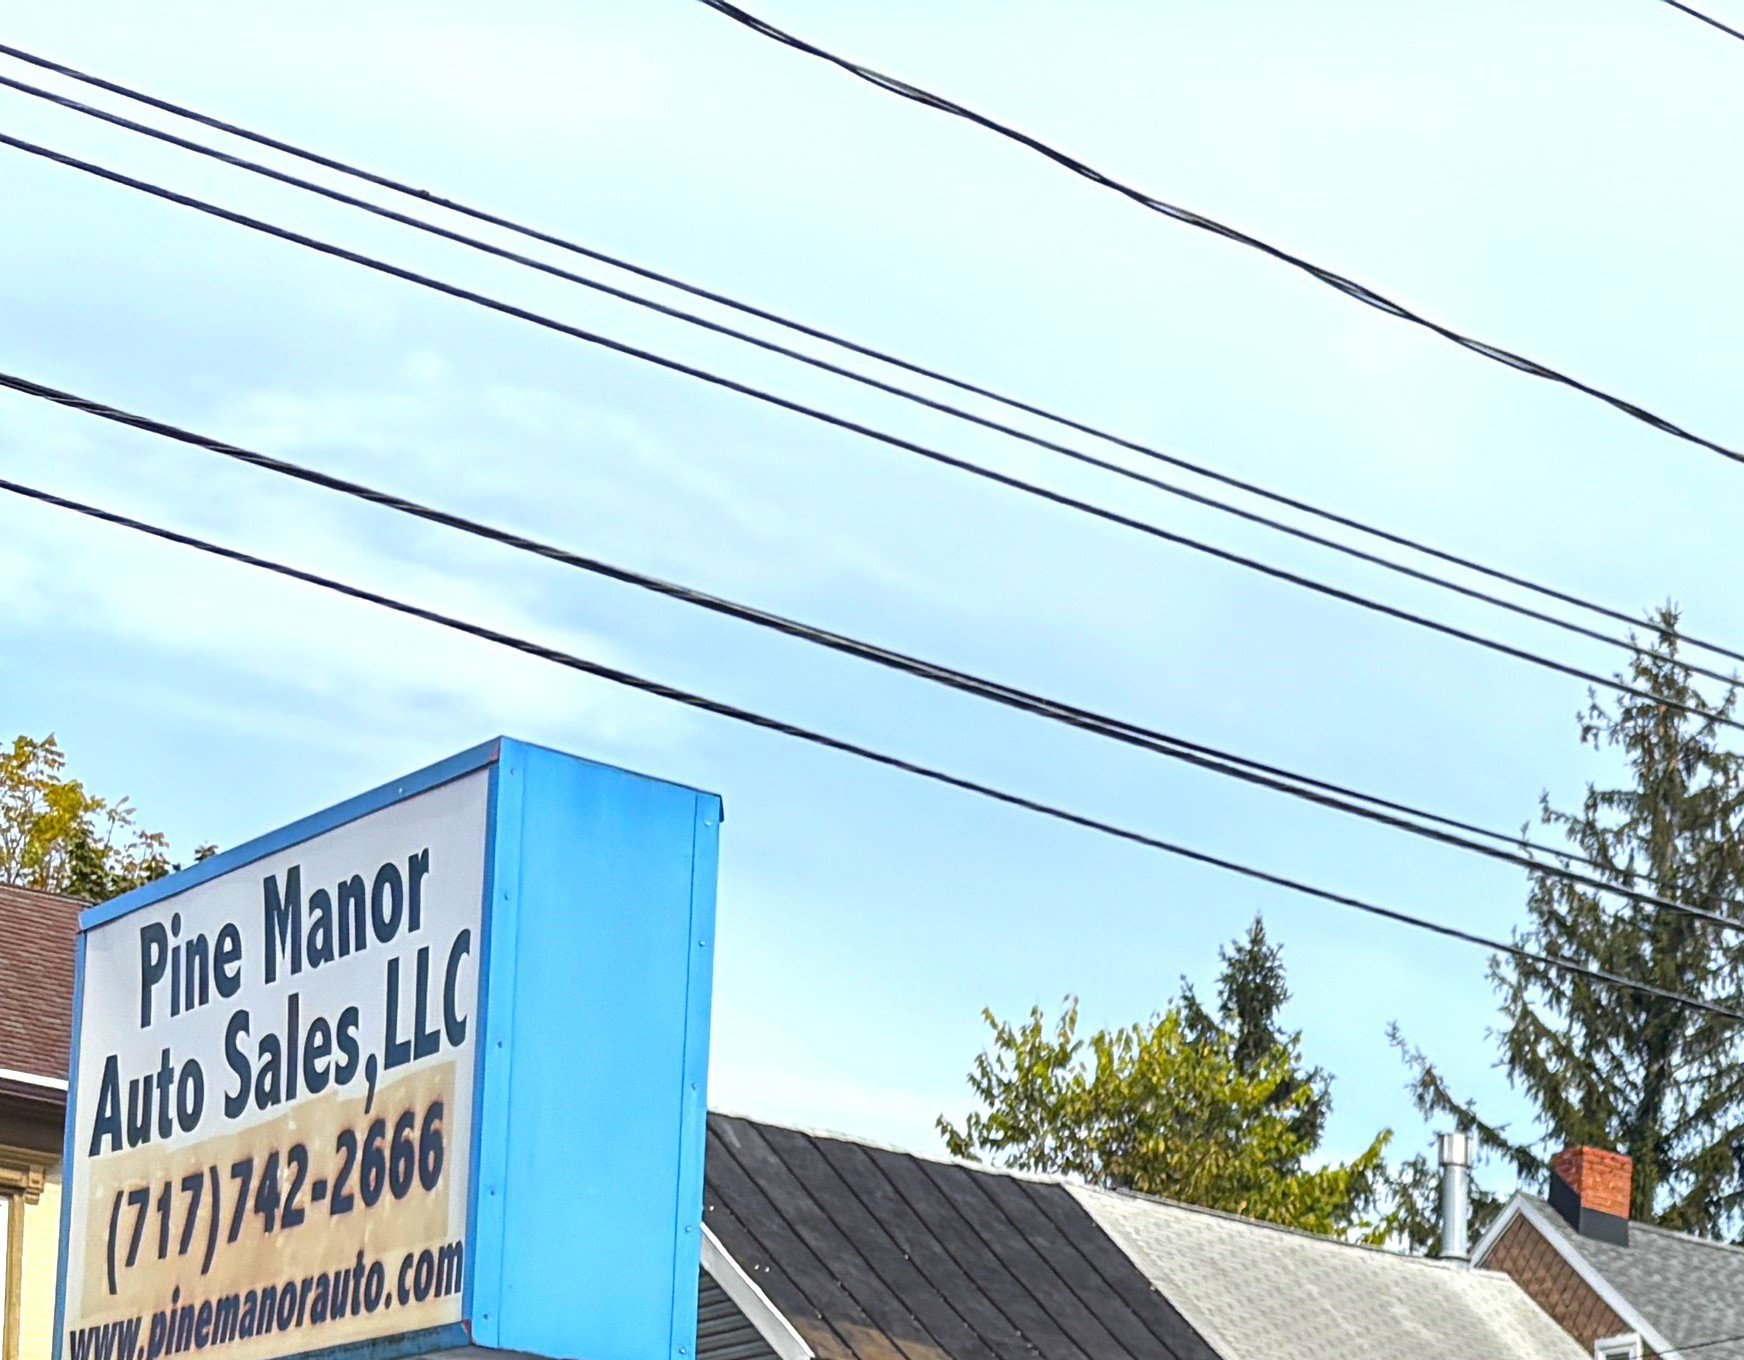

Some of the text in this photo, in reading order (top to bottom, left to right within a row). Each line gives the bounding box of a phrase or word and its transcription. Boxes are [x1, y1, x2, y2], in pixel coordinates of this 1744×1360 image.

[140, 847, 430, 1027] Pine Manor
[89, 1048, 205, 1157] Auto
